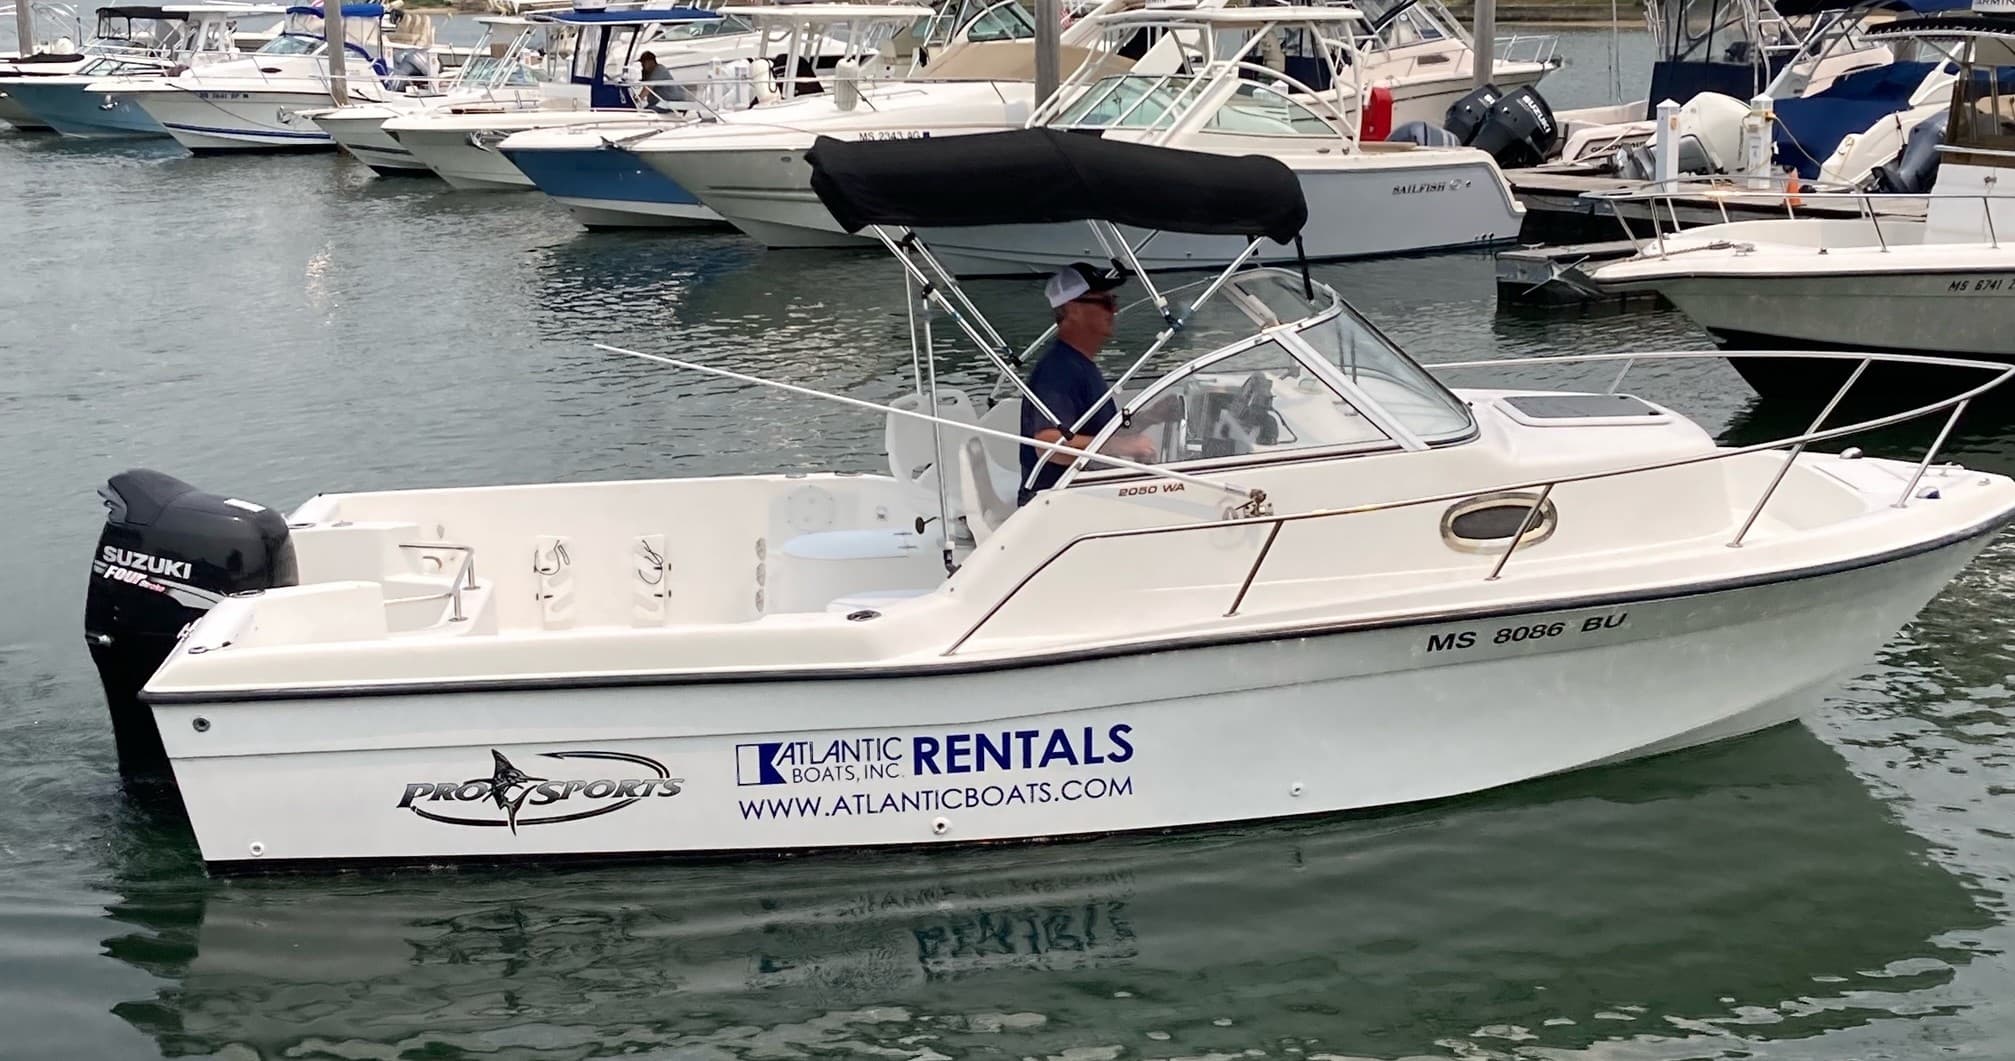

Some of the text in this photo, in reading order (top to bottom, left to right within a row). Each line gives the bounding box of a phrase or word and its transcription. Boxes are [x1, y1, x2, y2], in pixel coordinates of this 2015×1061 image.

[1522, 95, 1552, 134] SUZUKI
[858, 131, 875, 141] MS
[1391, 183, 1447, 195] SAILFISH
[1947, 280, 1969, 291] MS
[1975, 279, 2003, 291] 6741
[1118, 483, 1185, 497] 2050 WA
[102, 545, 192, 580] SUZUKI
[1426, 612, 1628, 652] MS 8086 BU
[776, 736, 903, 767] ATLANTIC
[913, 723, 1134, 776] RENTALS
[792, 762, 905, 784] BOATS, INC.
[738, 775, 1133, 821] WWW.ATLANTICBOATS.COM
